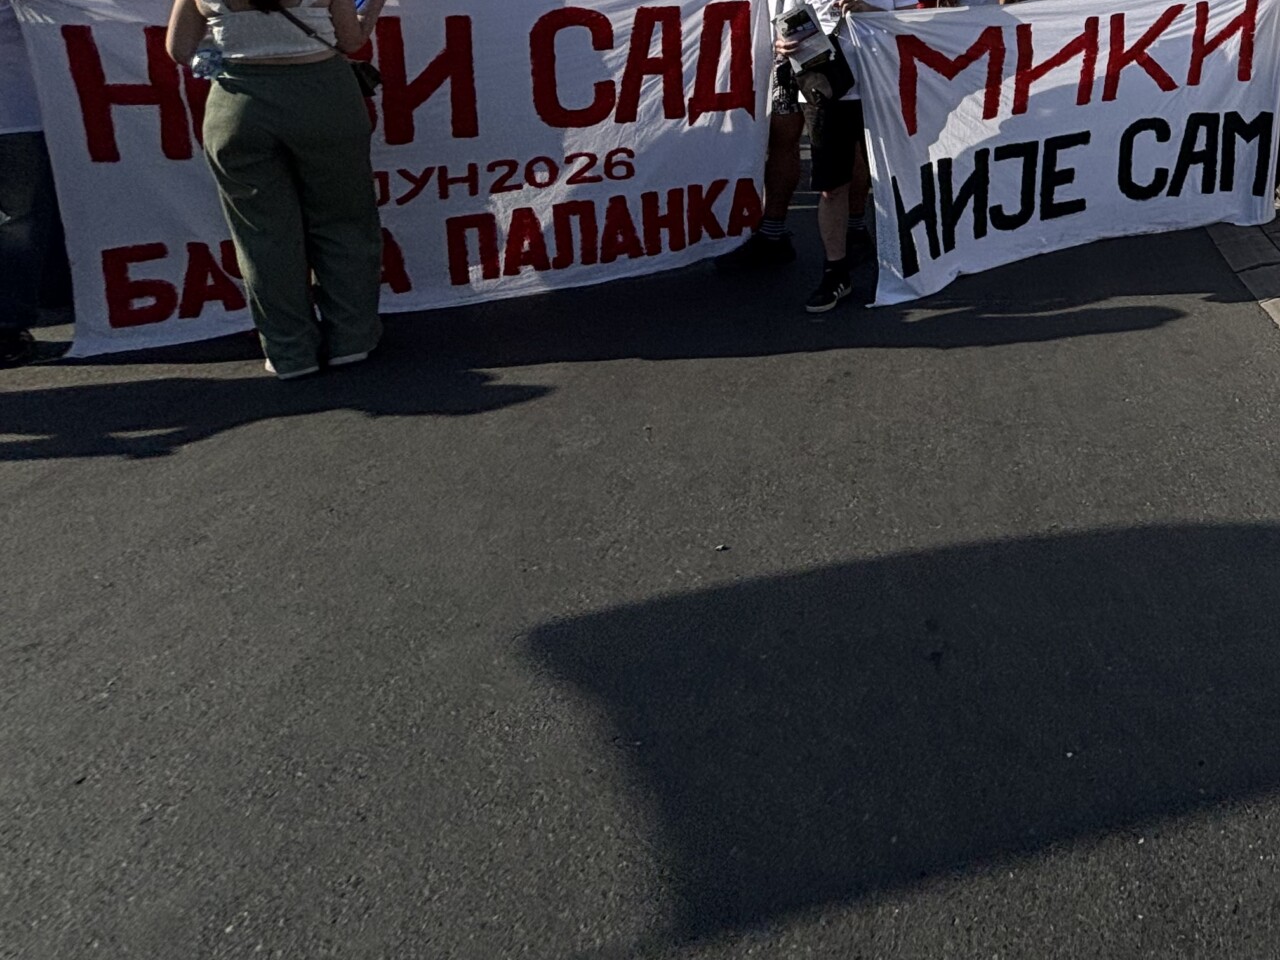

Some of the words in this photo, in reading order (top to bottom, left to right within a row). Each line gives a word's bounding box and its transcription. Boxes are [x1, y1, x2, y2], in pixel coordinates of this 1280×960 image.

[60, 14, 479, 163] НИ
[529, 0, 756, 128] САД
[445, 177, 764, 286] ПАЛАНКА
[891, 130, 1091, 279] НИЈЕ
[1117, 110, 1274, 200] САМ
